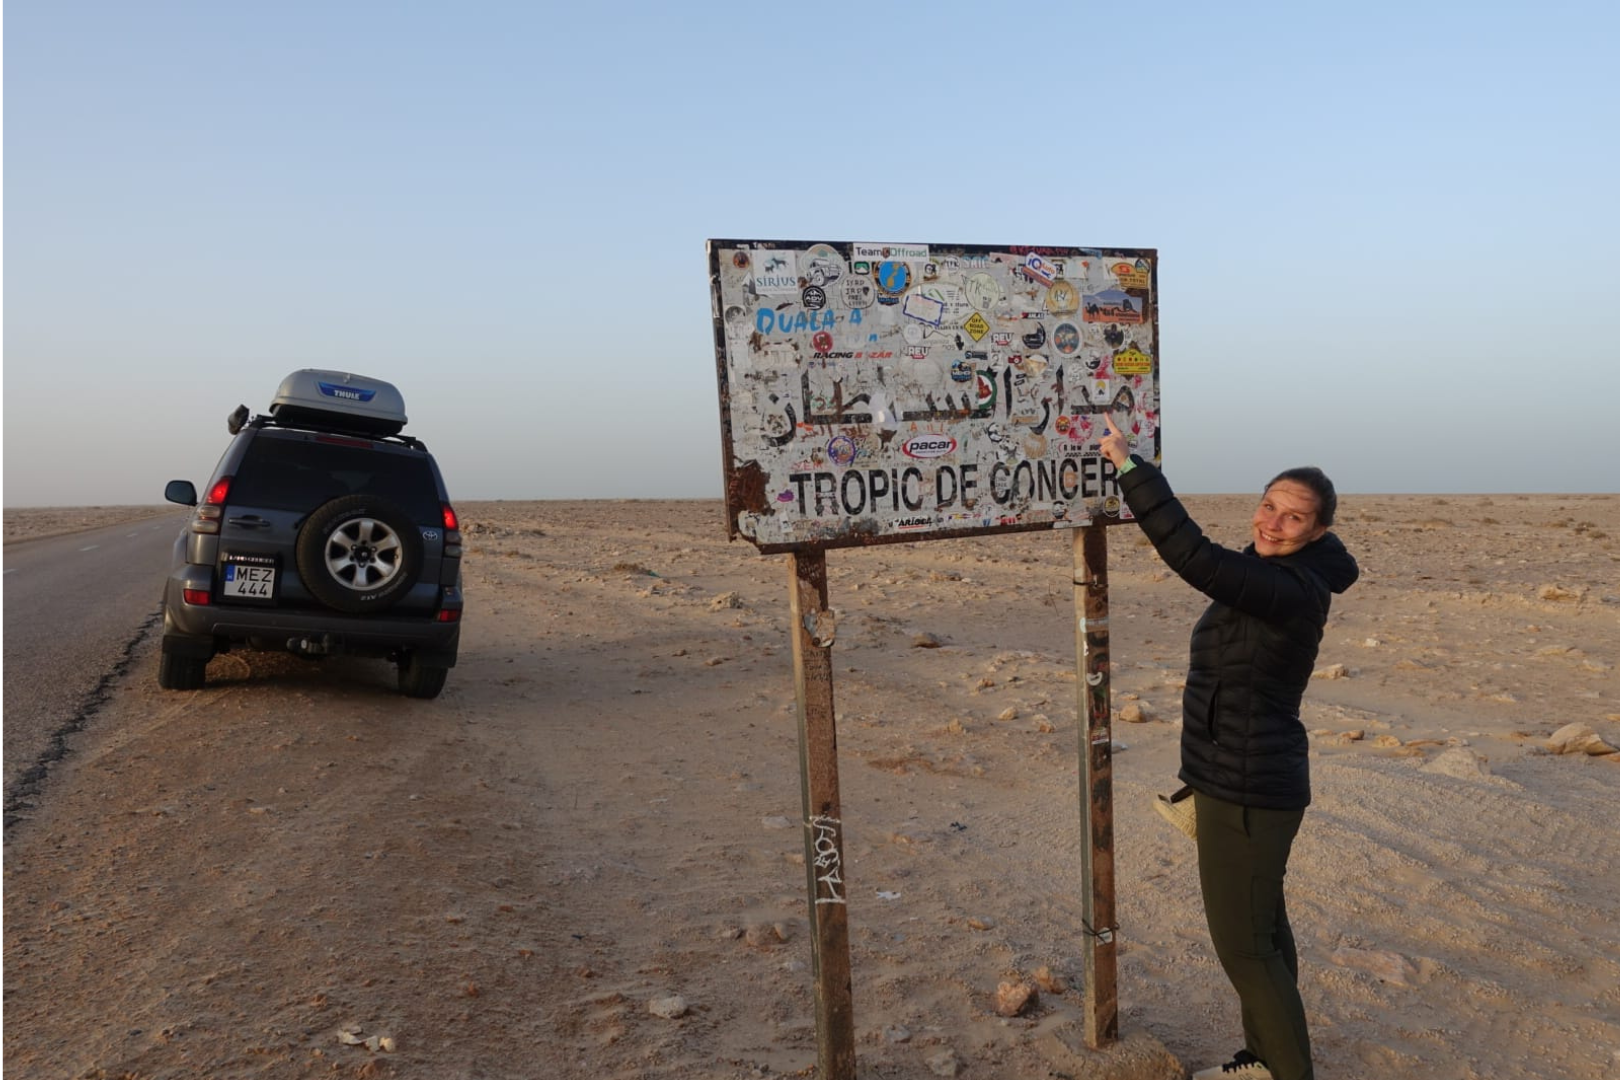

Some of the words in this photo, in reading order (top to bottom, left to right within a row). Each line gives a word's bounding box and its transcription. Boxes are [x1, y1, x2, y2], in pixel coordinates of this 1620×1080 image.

[856, 247, 882, 256] Team
[890, 247, 927, 257] Offroad
[813, 351, 854, 359] RACING
[854, 351, 893, 359] BZAR
[334, 389, 360, 400] THULE
[909, 438, 953, 453] pacar
[789, 466, 924, 516] TROPIC
[936, 463, 978, 507] DE
[236, 567, 273, 582] MEZ
[237, 581, 268, 596] 444
